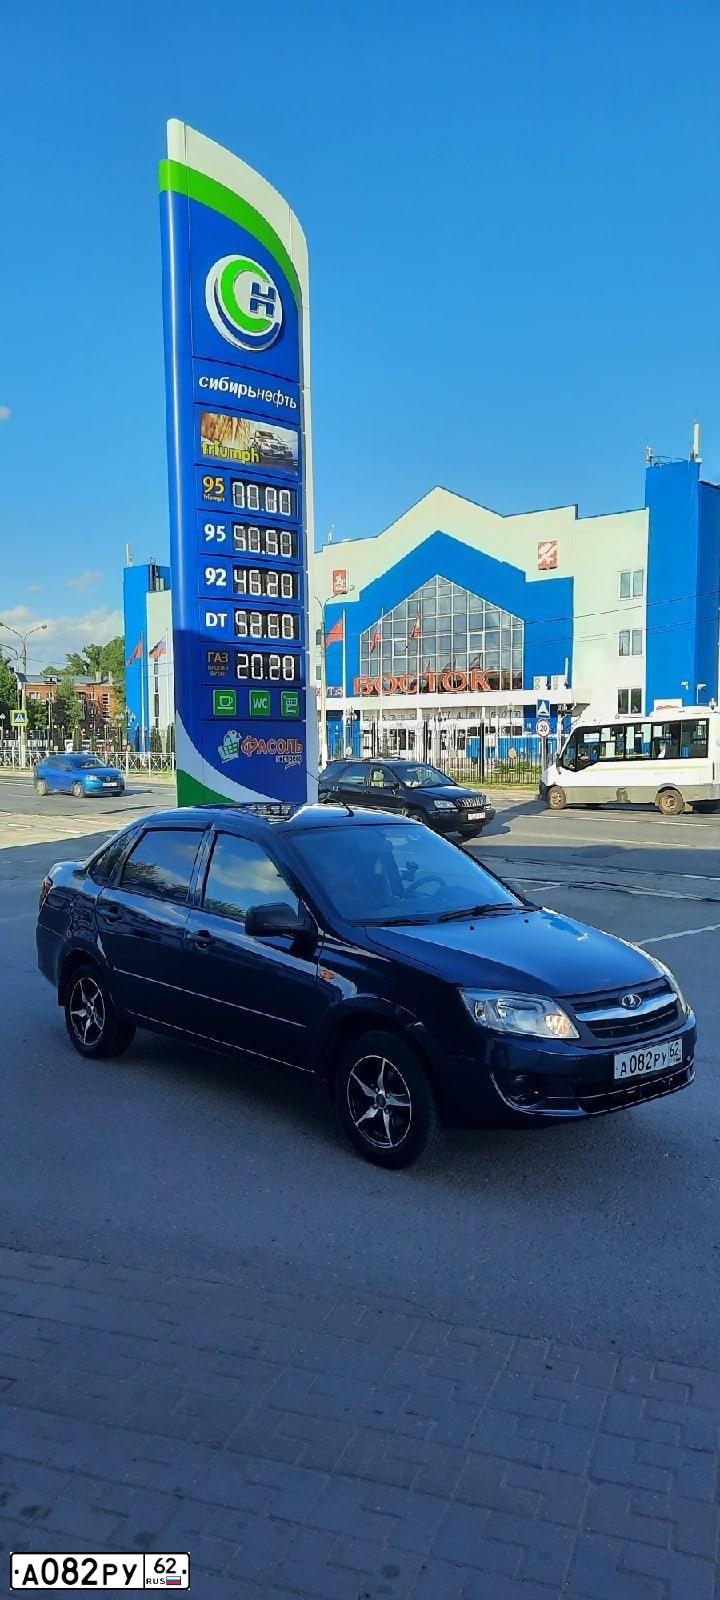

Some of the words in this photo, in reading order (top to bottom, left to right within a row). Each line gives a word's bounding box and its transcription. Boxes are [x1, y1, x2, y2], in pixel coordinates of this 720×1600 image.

[199, 376, 297, 409] сибирьнефть
[201, 440, 260, 463] triumph
[203, 476, 225, 494] 95
[204, 523, 226, 543] 95
[205, 567, 227, 587] 92
[234, 569, 293, 599] 46.20
[235, 610, 294, 640] 52.60
[207, 651, 229, 663] ГАЗ
[237, 653, 295, 681] 20.20
[353, 670, 492, 696] ВОСТОК
[252, 697, 269, 710] WC
[540, 724, 548, 733] 20
[241, 736, 303, 757] ФАСОЛЬ
[620, 1051, 667, 1077] А082РУ
[669, 1041, 679, 1058] 62
